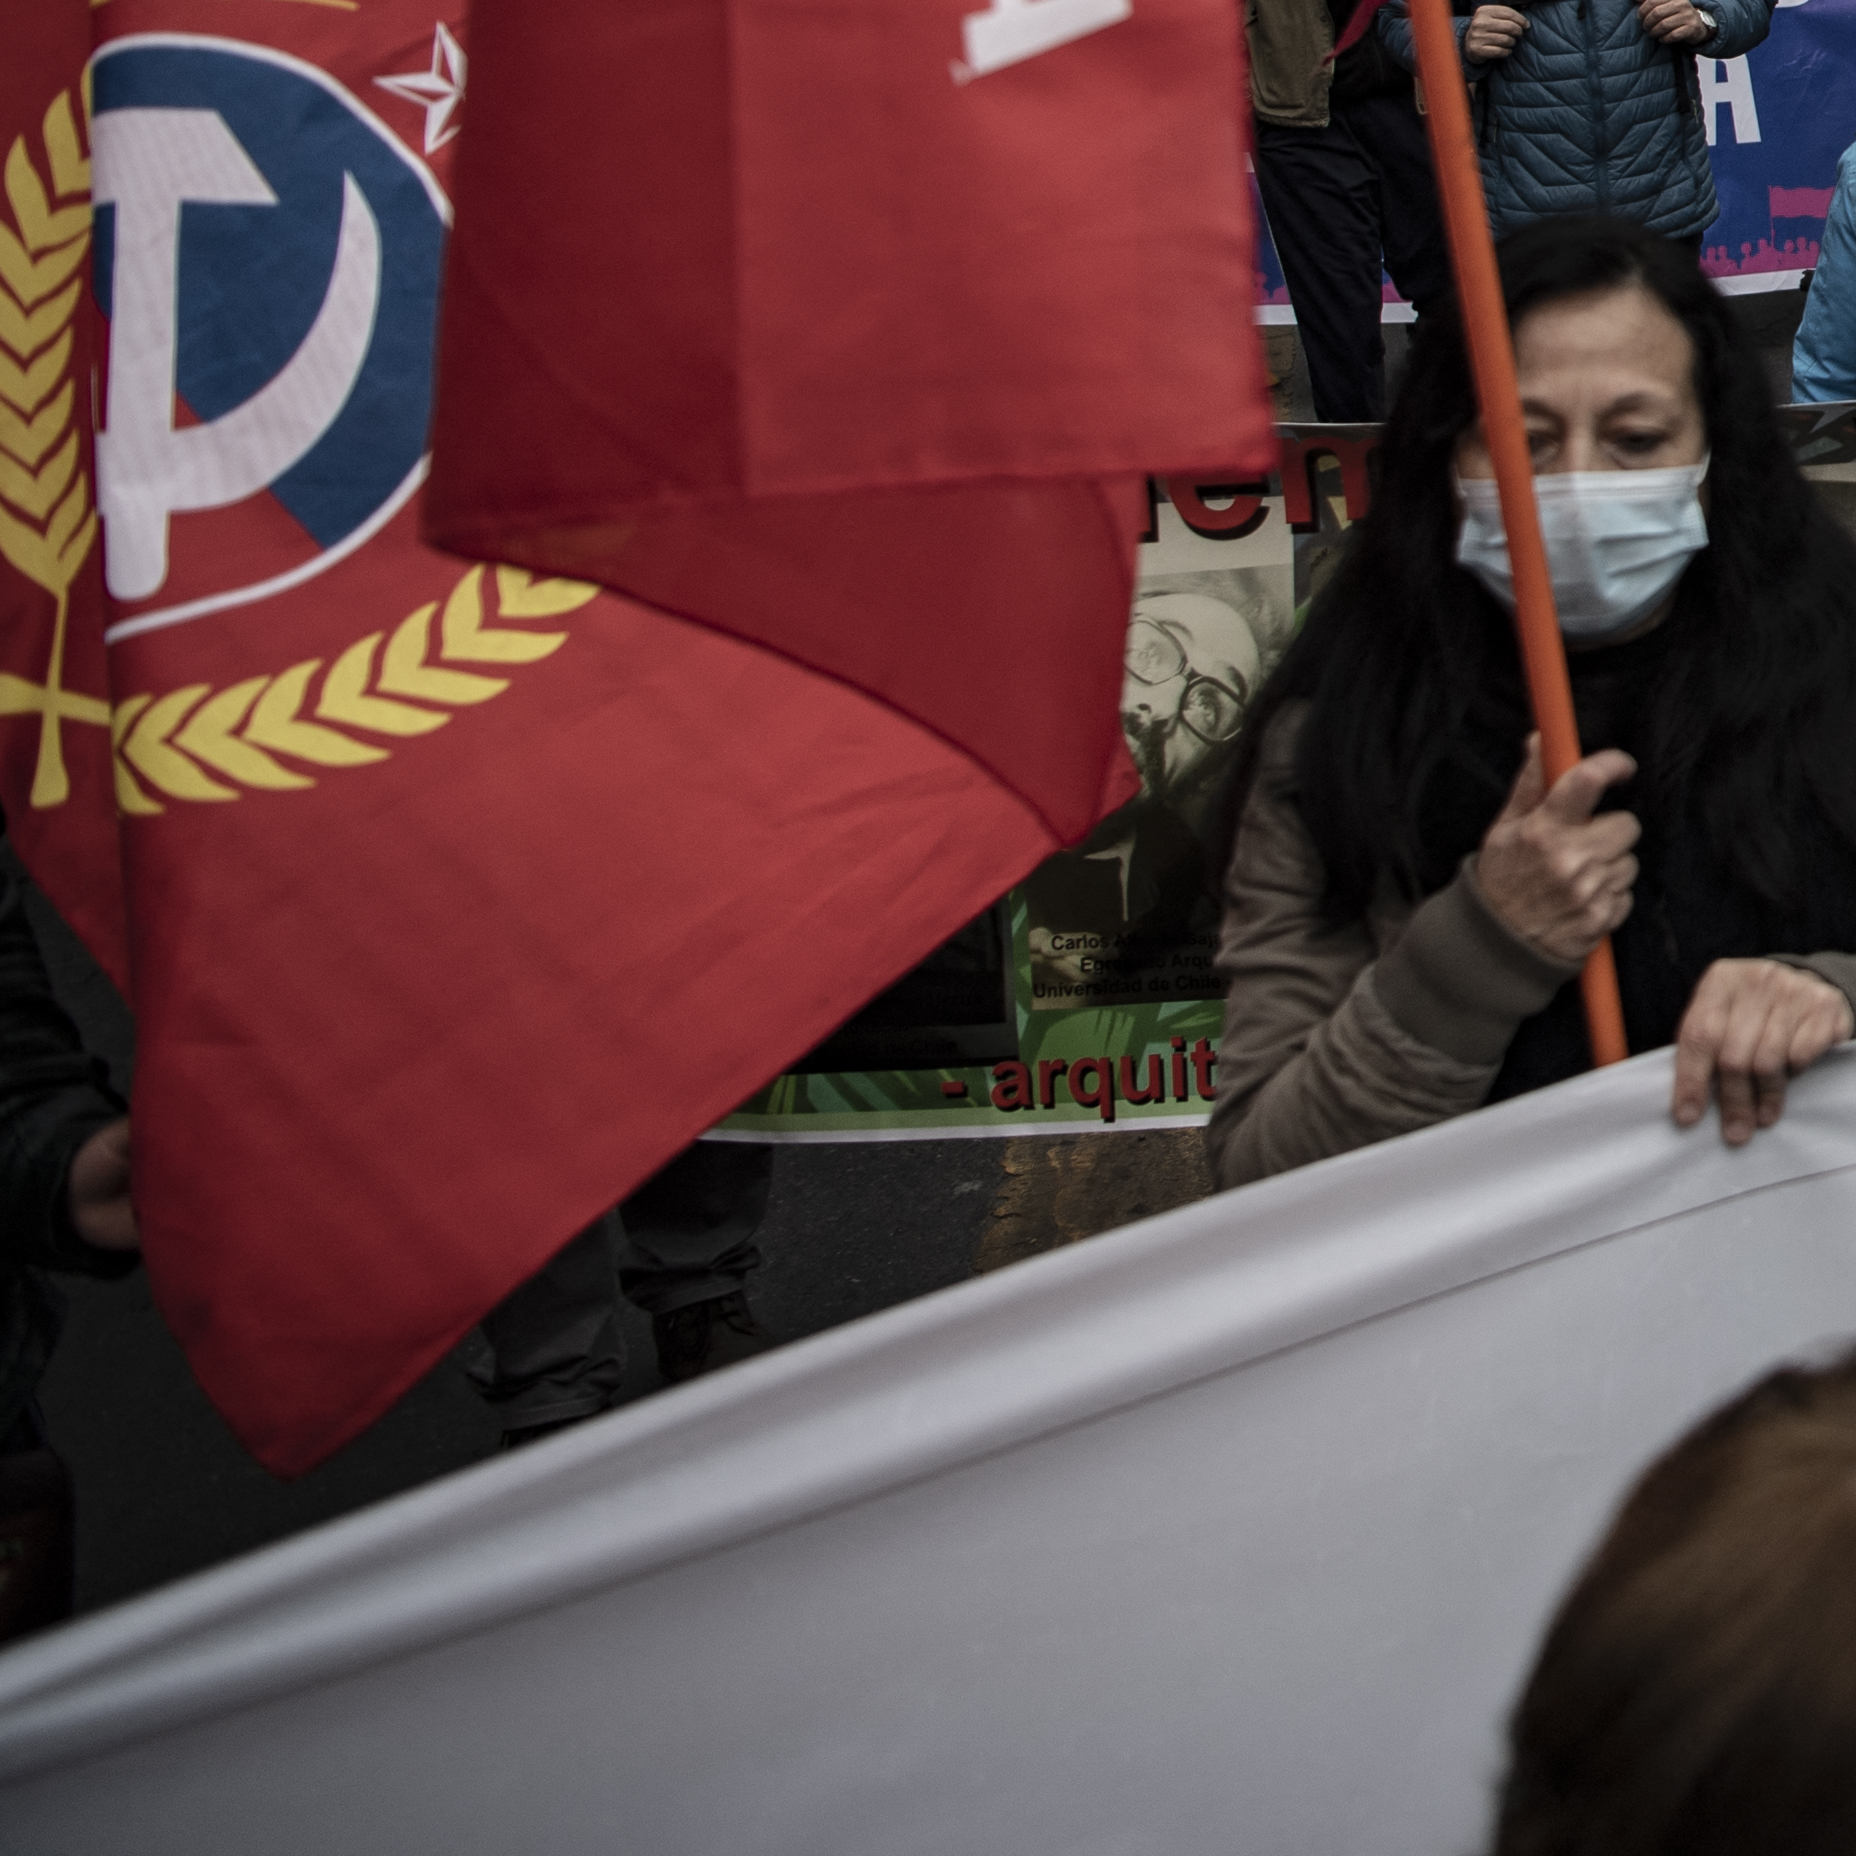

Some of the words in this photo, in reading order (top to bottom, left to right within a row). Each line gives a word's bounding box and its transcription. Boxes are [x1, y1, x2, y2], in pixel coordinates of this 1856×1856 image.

[1051, 933, 1110, 952] Carlos
[1032, 978, 1143, 1000] Universidad
[1148, 975, 1170, 993] de
[1175, 973, 1222, 991] Chile
